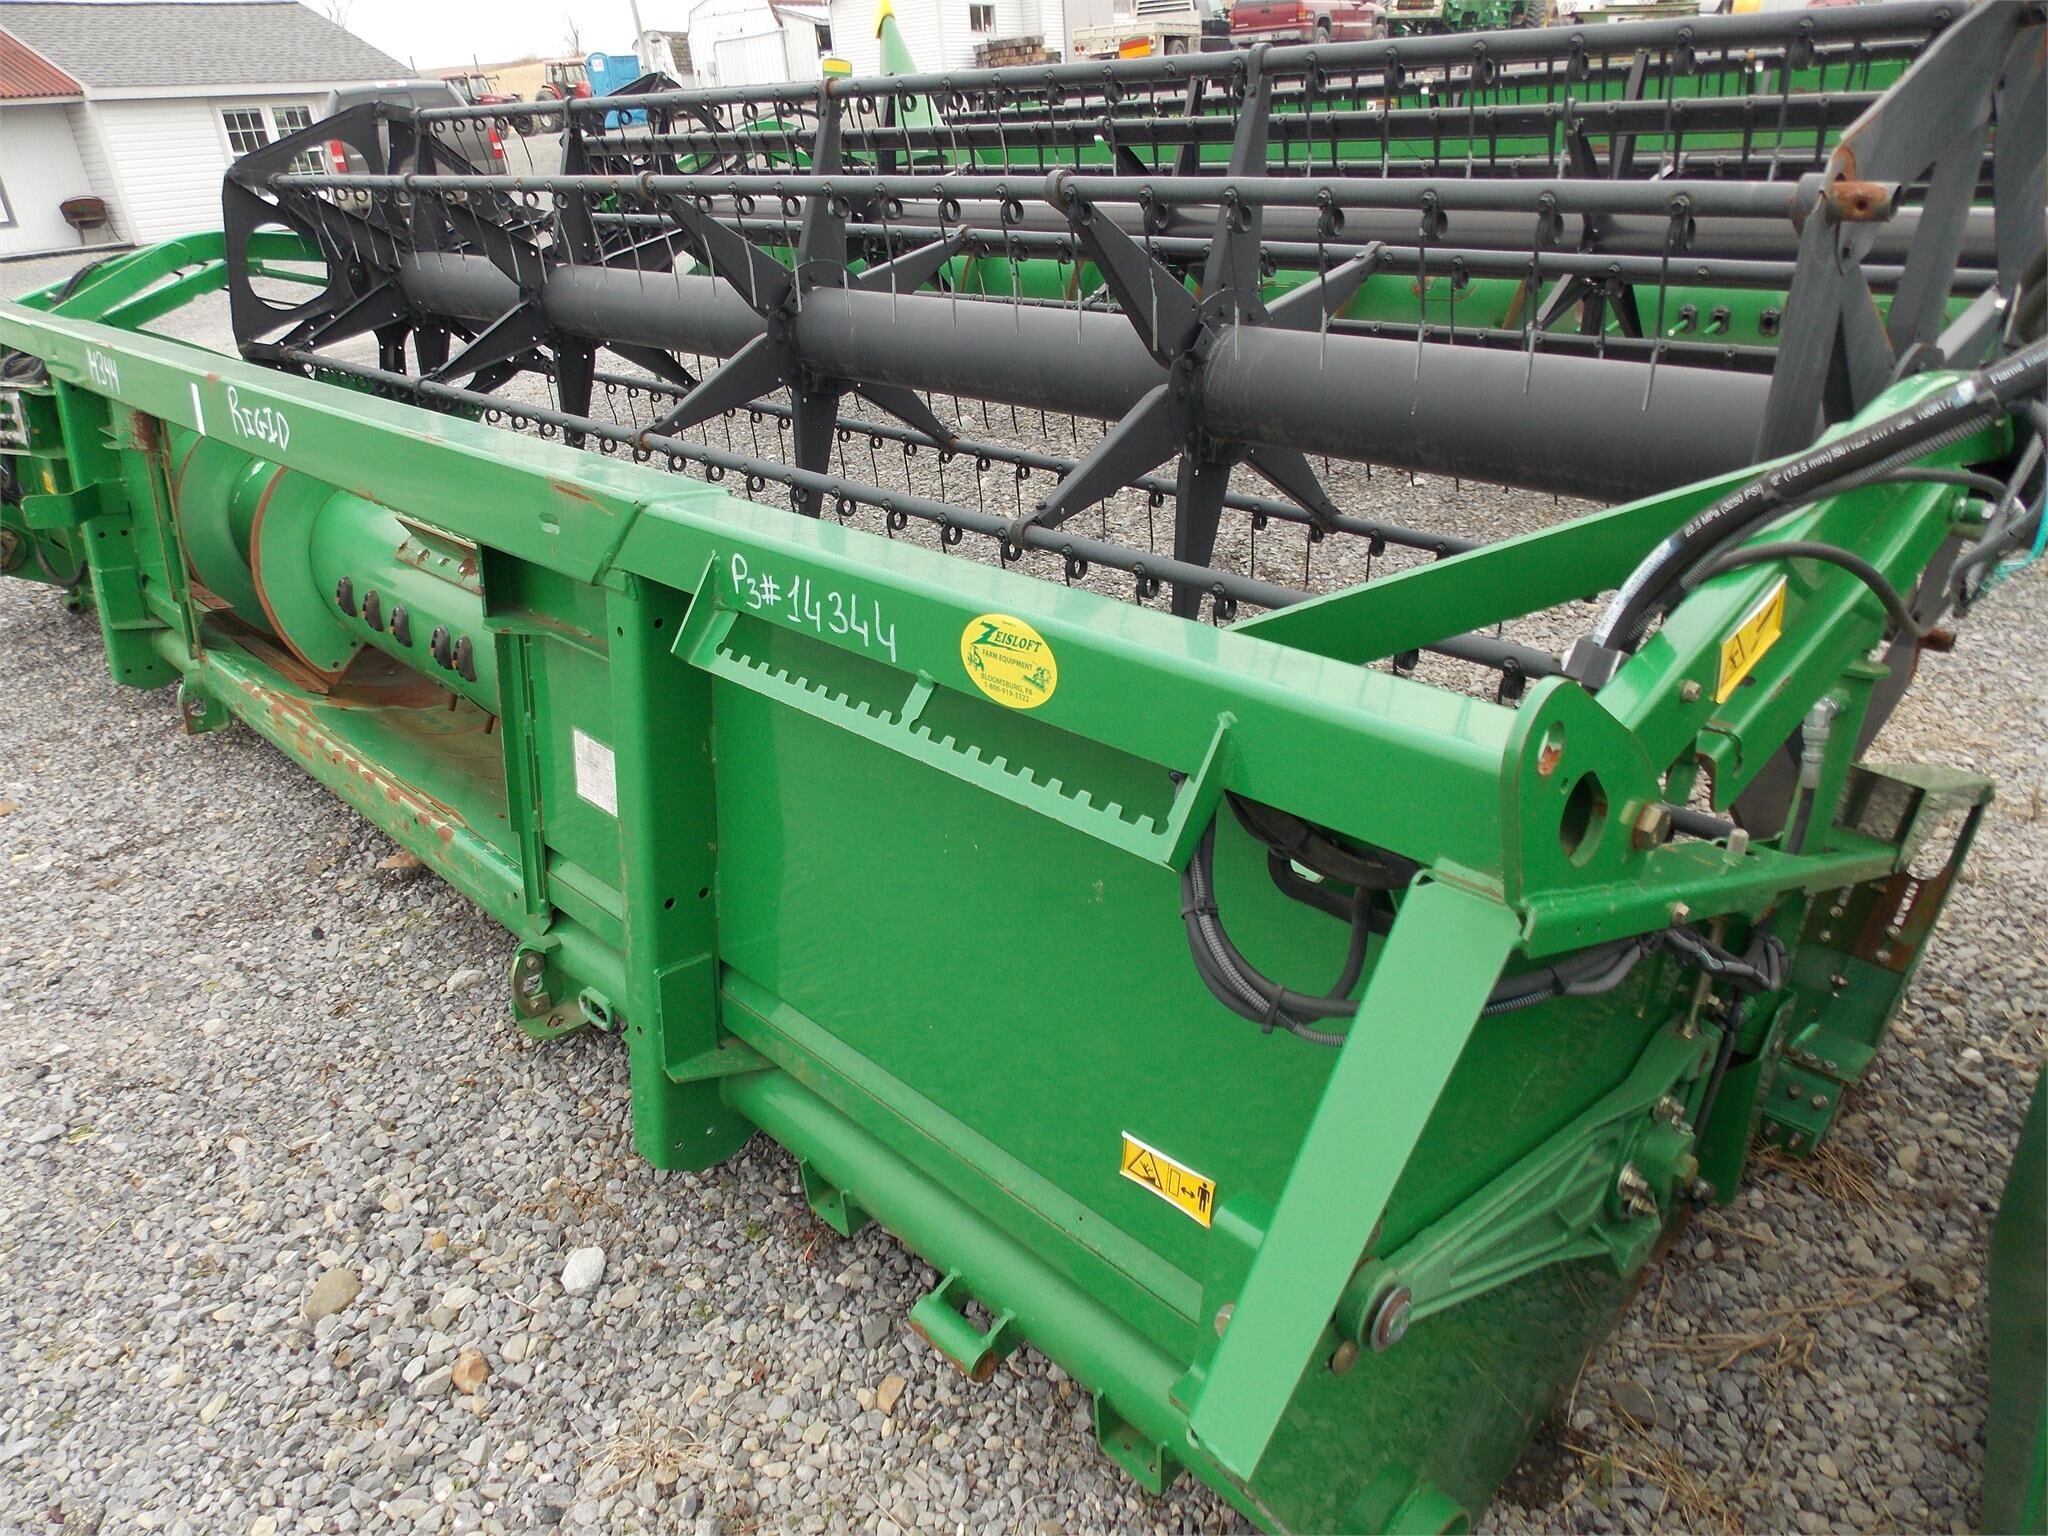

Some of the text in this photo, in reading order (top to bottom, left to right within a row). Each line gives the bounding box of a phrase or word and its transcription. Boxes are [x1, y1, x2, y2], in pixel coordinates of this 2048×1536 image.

[228, 385, 290, 450] RIGID
[1702, 508, 1720, 526] MPa
[982, 648, 1034, 671] FARM EQUIPMENT
